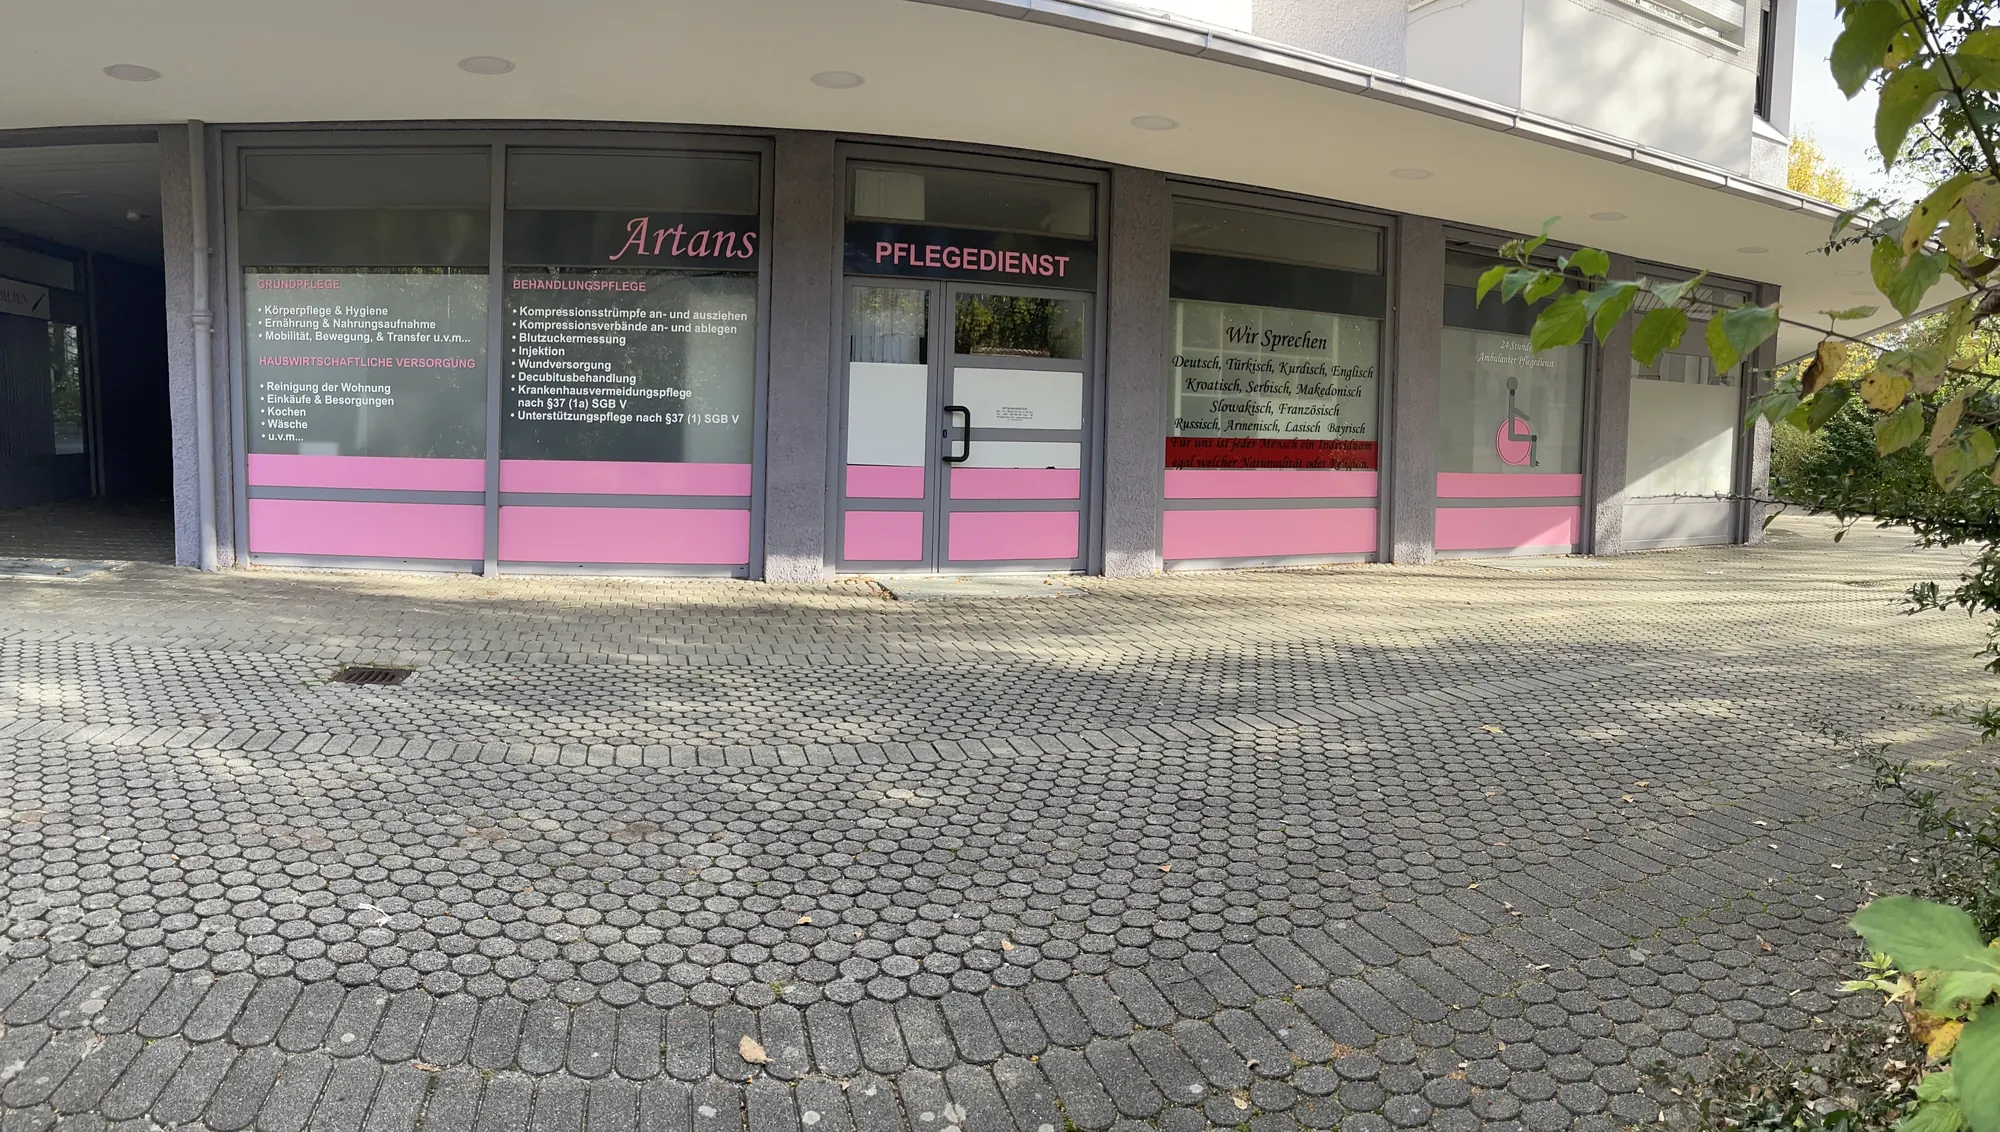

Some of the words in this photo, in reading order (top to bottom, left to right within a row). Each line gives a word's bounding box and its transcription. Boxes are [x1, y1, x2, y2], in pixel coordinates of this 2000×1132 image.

[609, 216, 757, 261] Artans
[875, 242, 1069, 277] PFLEGEDIENST
[258, 280, 340, 289] GRUNDPFLEGE
[513, 280, 646, 292] BEHANDLUNGSPFLEGE
[265, 306, 331, 316] Körperpflege
[335, 306, 342, 315] &
[345, 306, 388, 317] Hygiene
[520, 307, 646, 318] Kompressionsstrümpfe
[649, 310, 666, 318] an-
[670, 309, 689, 319] und
[693, 311, 747, 321] ausziehen
[265, 319, 319, 330] Ernährung
[323, 319, 329, 328] &
[333, 320, 435, 330] Nahrungsaufnahme
[520, 320, 647, 331] Kompressionsverbände
[651, 324, 668, 332] an-
[671, 323, 691, 332] und
[694, 324, 737, 335] ablegen
[266, 332, 312, 342] Mobilität,
[315, 332, 373, 343] Bewegung,
[377, 333, 384, 341] &
[387, 332, 430, 342] Transfer
[519, 333, 626, 346] Blutzuckermessung
[1226, 326, 1259, 344] Wir
[1261, 330, 1327, 351] Sprechen
[519, 346, 565, 357] Injektion
[1501, 340, 1508, 349] 24
[1510, 341, 1533, 351] Stunde
[260, 357, 392, 367] HAUSWIRTSCHAFTLICHE
[396, 358, 475, 368] VERSORGUNG
[519, 359, 611, 371] Wundversorgung
[1477, 352, 1517, 364] Ambulanter
[1518, 356, 1554, 368] Pflegedienst
[1172, 355, 1222, 370] Deutsch,
[1225, 358, 1274, 373] Türkisch,
[1278, 361, 1328, 376] Kurdisch,
[1331, 365, 1373, 380] Englisch
[519, 373, 636, 384] Decubitusbehandlung
[267, 382, 318, 393] Reinigung
[322, 383, 338, 392] der
[341, 383, 391, 394] Wohnung
[519, 385, 692, 398] Krankenhausvermeidungspflege
[1185, 378, 1242, 393] Kroatisch,
[1246, 380, 1292, 395] Serbisch,
[1296, 383, 1361, 398] Makedonisch
[267, 395, 311, 405] Einkäufe
[315, 396, 322, 404] &
[325, 396, 394, 407] Besorgungen
[518, 399, 543, 408] nach
[547, 399, 566, 409] §37
[569, 399, 588, 410] (1a)
[592, 400, 616, 408] SGB
[619, 400, 627, 409] V
[268, 407, 306, 416] Kochen
[1210, 400, 1274, 415] Slowakisch,
[1279, 403, 1340, 416] Französisch
[518, 411, 632, 423] Unterstützungspflege
[636, 414, 662, 423] nach
[665, 414, 684, 425] §37
[687, 414, 701, 425] (1)
[705, 415, 728, 424] SGB
[731, 415, 739, 424] V
[268, 420, 307, 429] Wäsche
[1174, 418, 1221, 431] Russisch,
[1224, 420, 1280, 433] Armenisch,
[1285, 421, 1320, 433] Lasisch
[1327, 422, 1366, 436] Bayrisch
[1171, 438, 1191, 447] Für
[1217, 438, 1229, 448] ist
[1230, 439, 1256, 452] jeder
[1260, 438, 1298, 449] Mensch
[1300, 441, 1314, 449] ein
[1172, 456, 1196, 470] egal
[1198, 457, 1237, 468] welcher
[1306, 457, 1326, 468] oder
